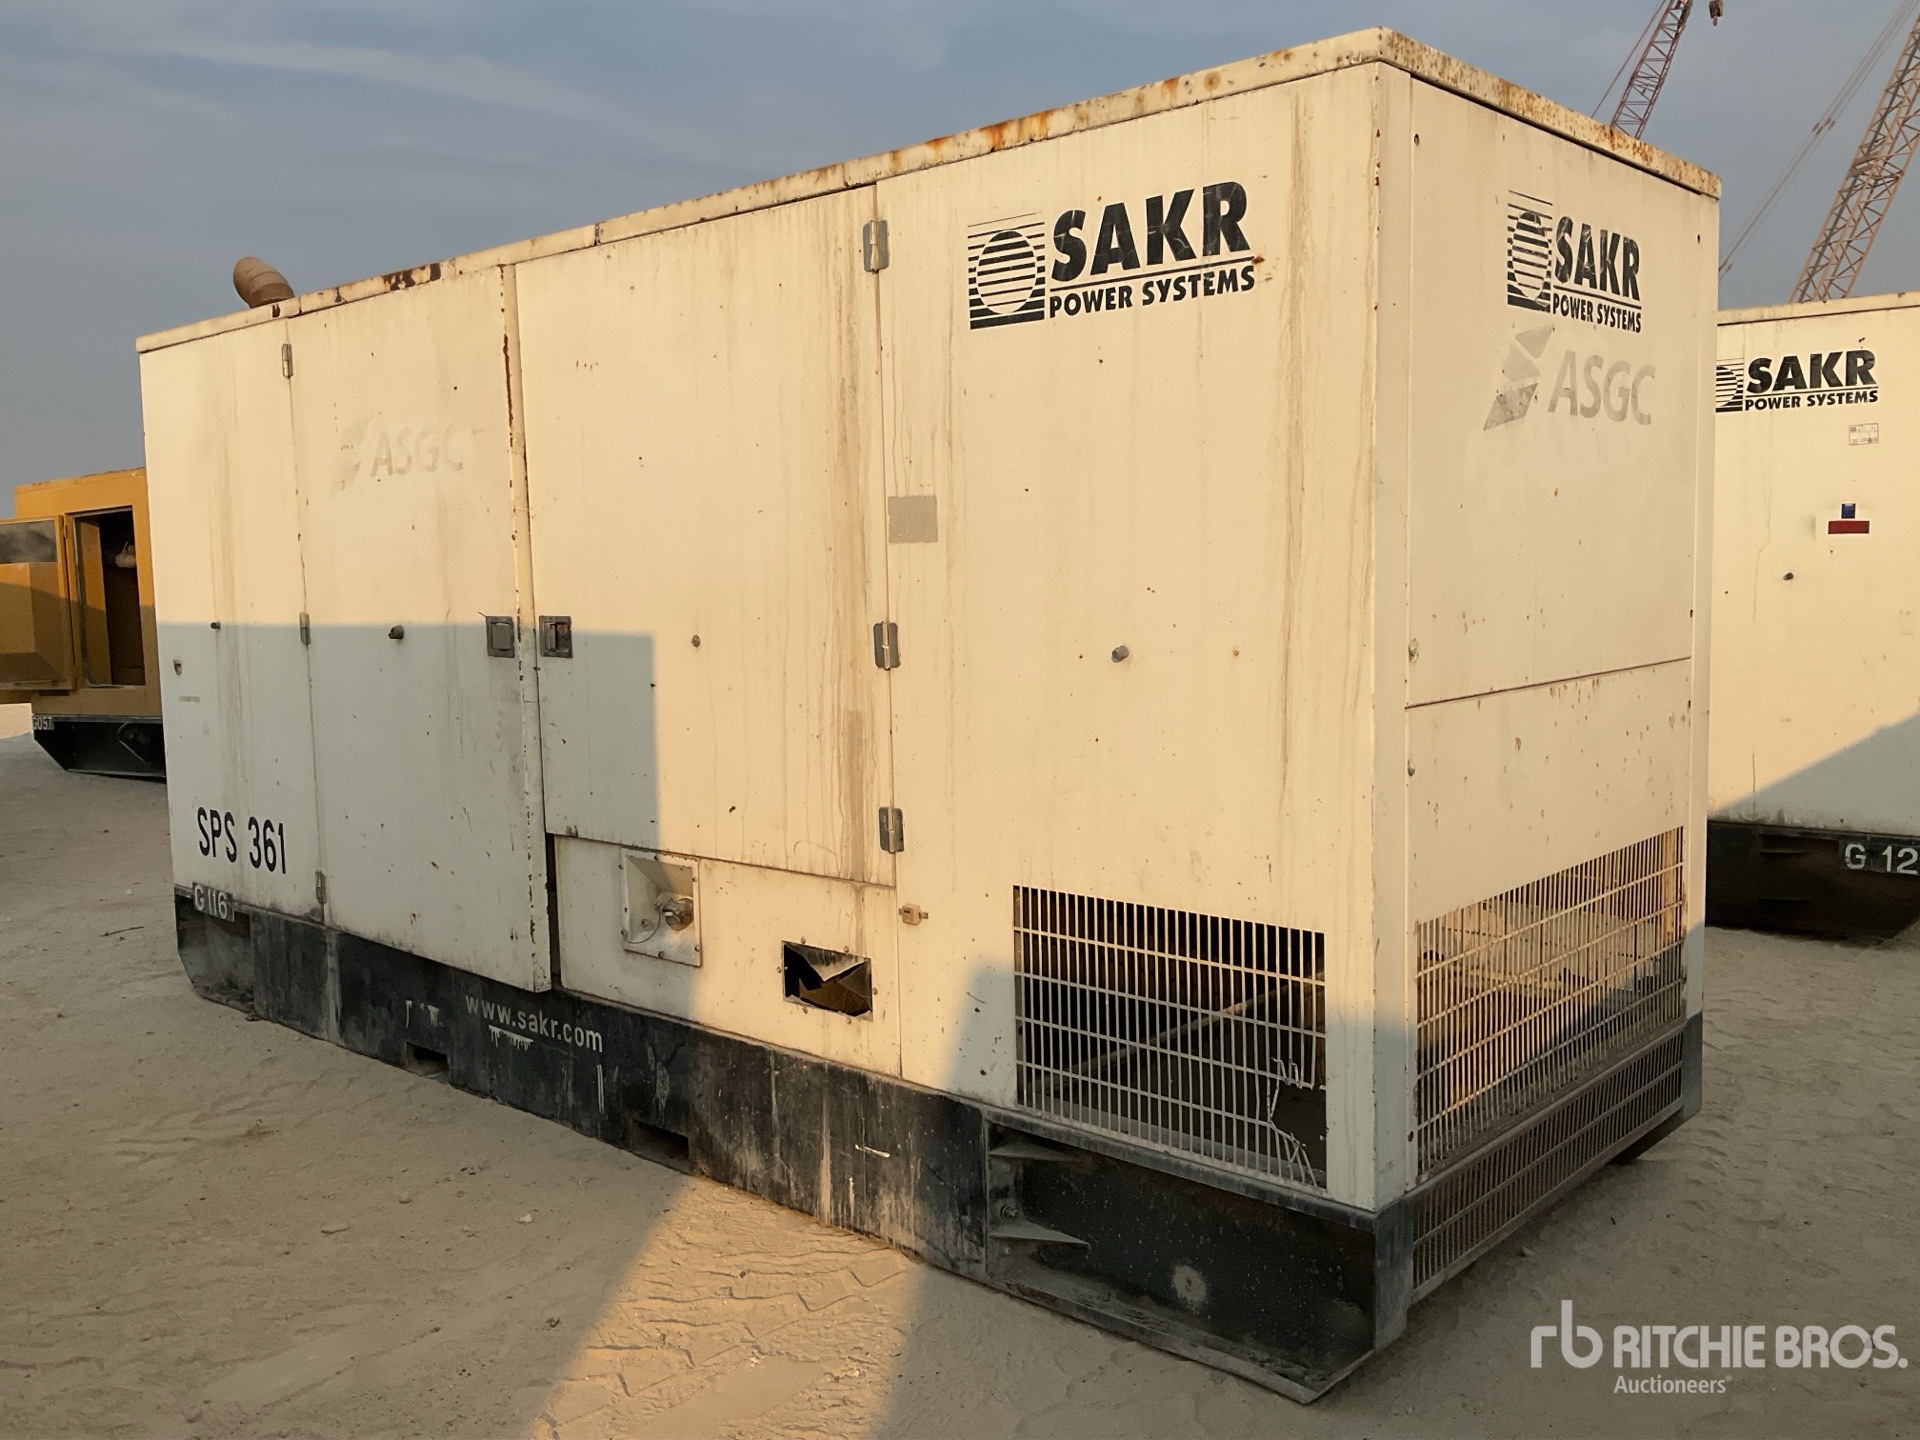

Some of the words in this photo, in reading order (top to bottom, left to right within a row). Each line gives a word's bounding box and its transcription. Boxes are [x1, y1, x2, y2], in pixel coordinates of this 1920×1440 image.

[1051, 181, 1251, 282] SAKR
[1554, 215, 1641, 301] SAKR
[1050, 285, 1133, 318] POWER
[1142, 265, 1255, 306] SYSTEMS
[1552, 292, 1594, 323] POWER
[1596, 303, 1642, 334] SYSTEMS
[1547, 350, 1656, 426] ASGC
[1746, 349, 1877, 394] SAKR
[1745, 395, 1801, 411] POWER
[1807, 389, 1879, 407] SYSTEMS
[370, 425, 464, 477] ASGC
[197, 806, 237, 863] SPS
[248, 816, 287, 874] 361
[1844, 843, 1866, 870] G
[1881, 845, 1919, 875] 12
[465, 995, 603, 1053] www.sakr.com
